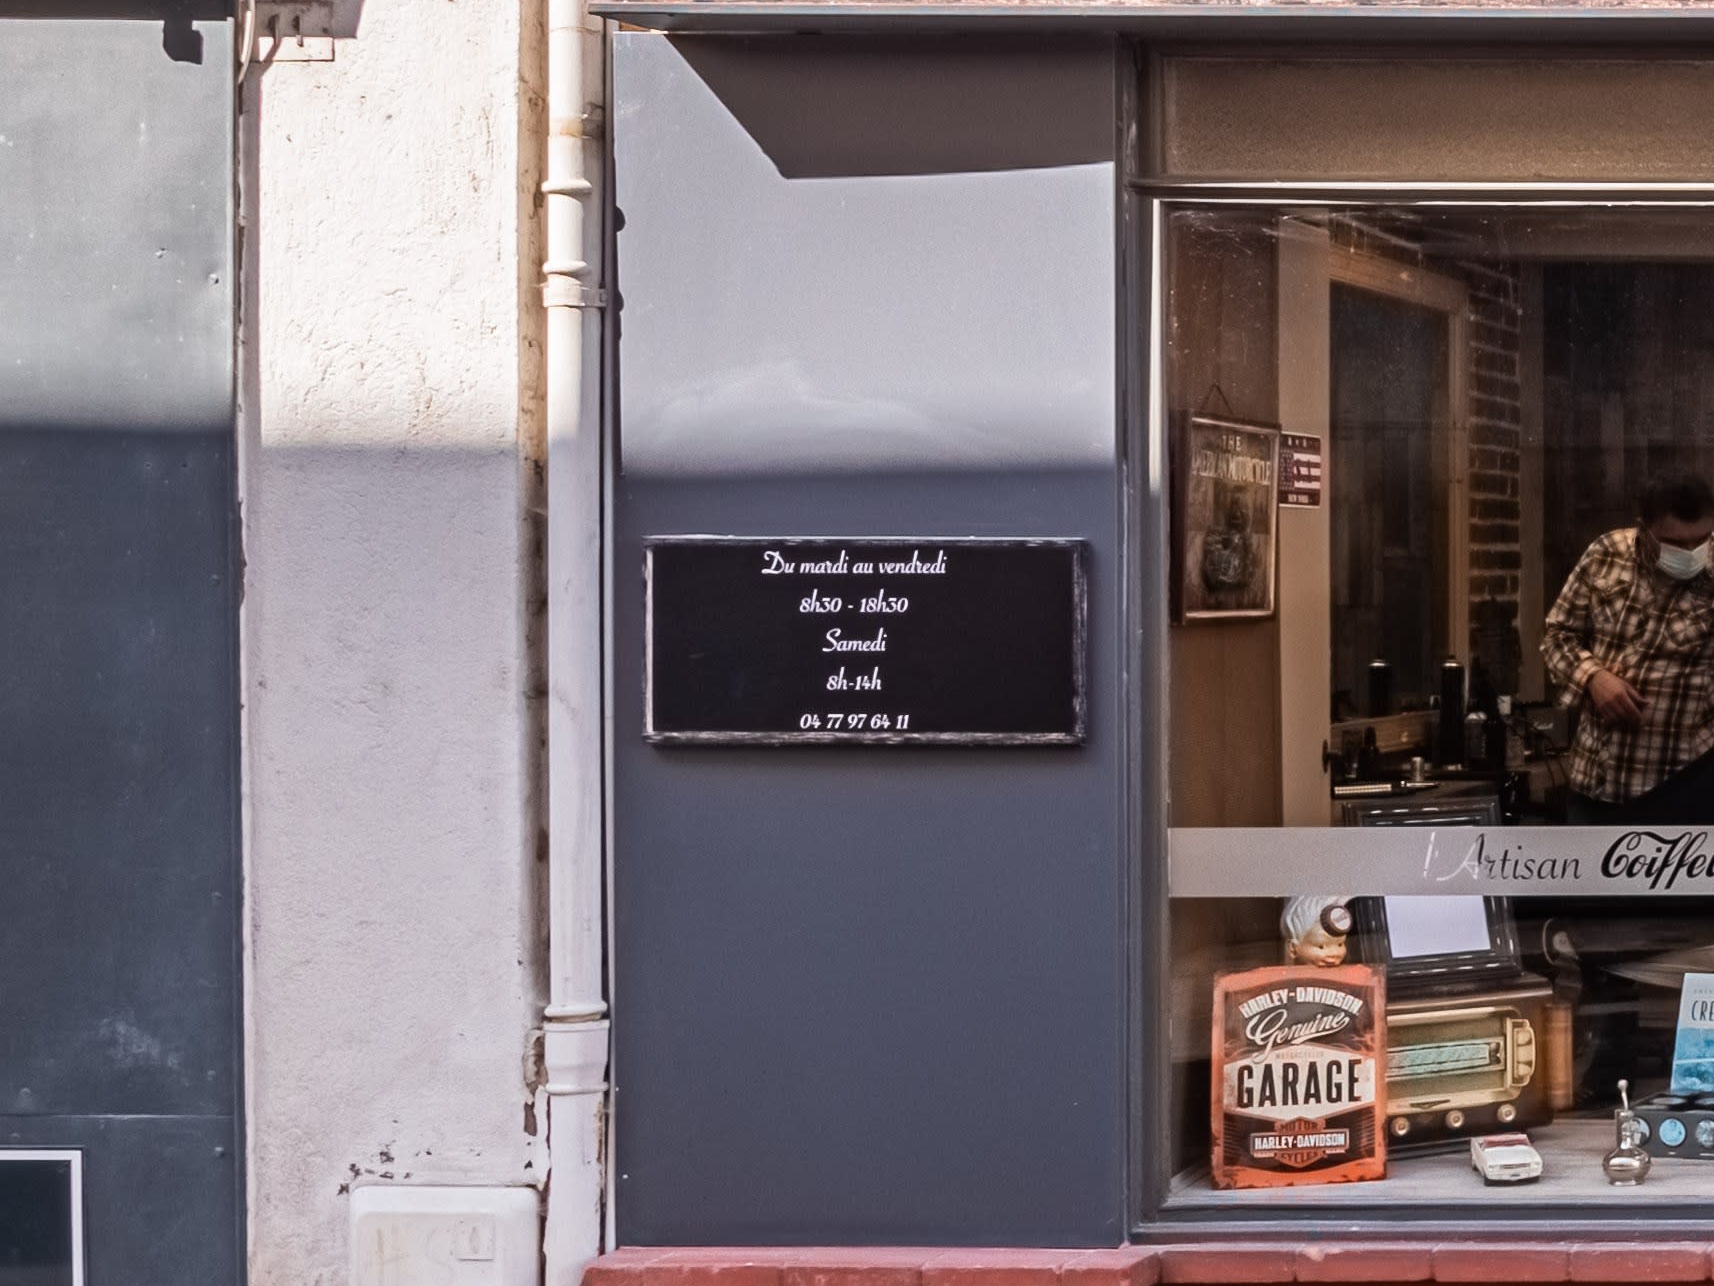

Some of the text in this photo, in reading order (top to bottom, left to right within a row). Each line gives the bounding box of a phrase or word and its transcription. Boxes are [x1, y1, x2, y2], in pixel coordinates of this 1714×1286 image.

[761, 550, 947, 575] Du mardi au vendredi
[799, 589, 842, 613] 8h30
[859, 589, 909, 613] 18h30
[822, 627, 887, 653] Samedi
[826, 666, 882, 691] 8h-14h
[799, 712, 910, 730] 04 77 97 64 11
[1238, 986, 1364, 1018] HARLEY-DAVIDSON
[1245, 1008, 1351, 1065] Genuine
[1236, 1058, 1362, 1109] GARAGE
[1253, 1132, 1346, 1150] HARLEY-DAVIDSON
